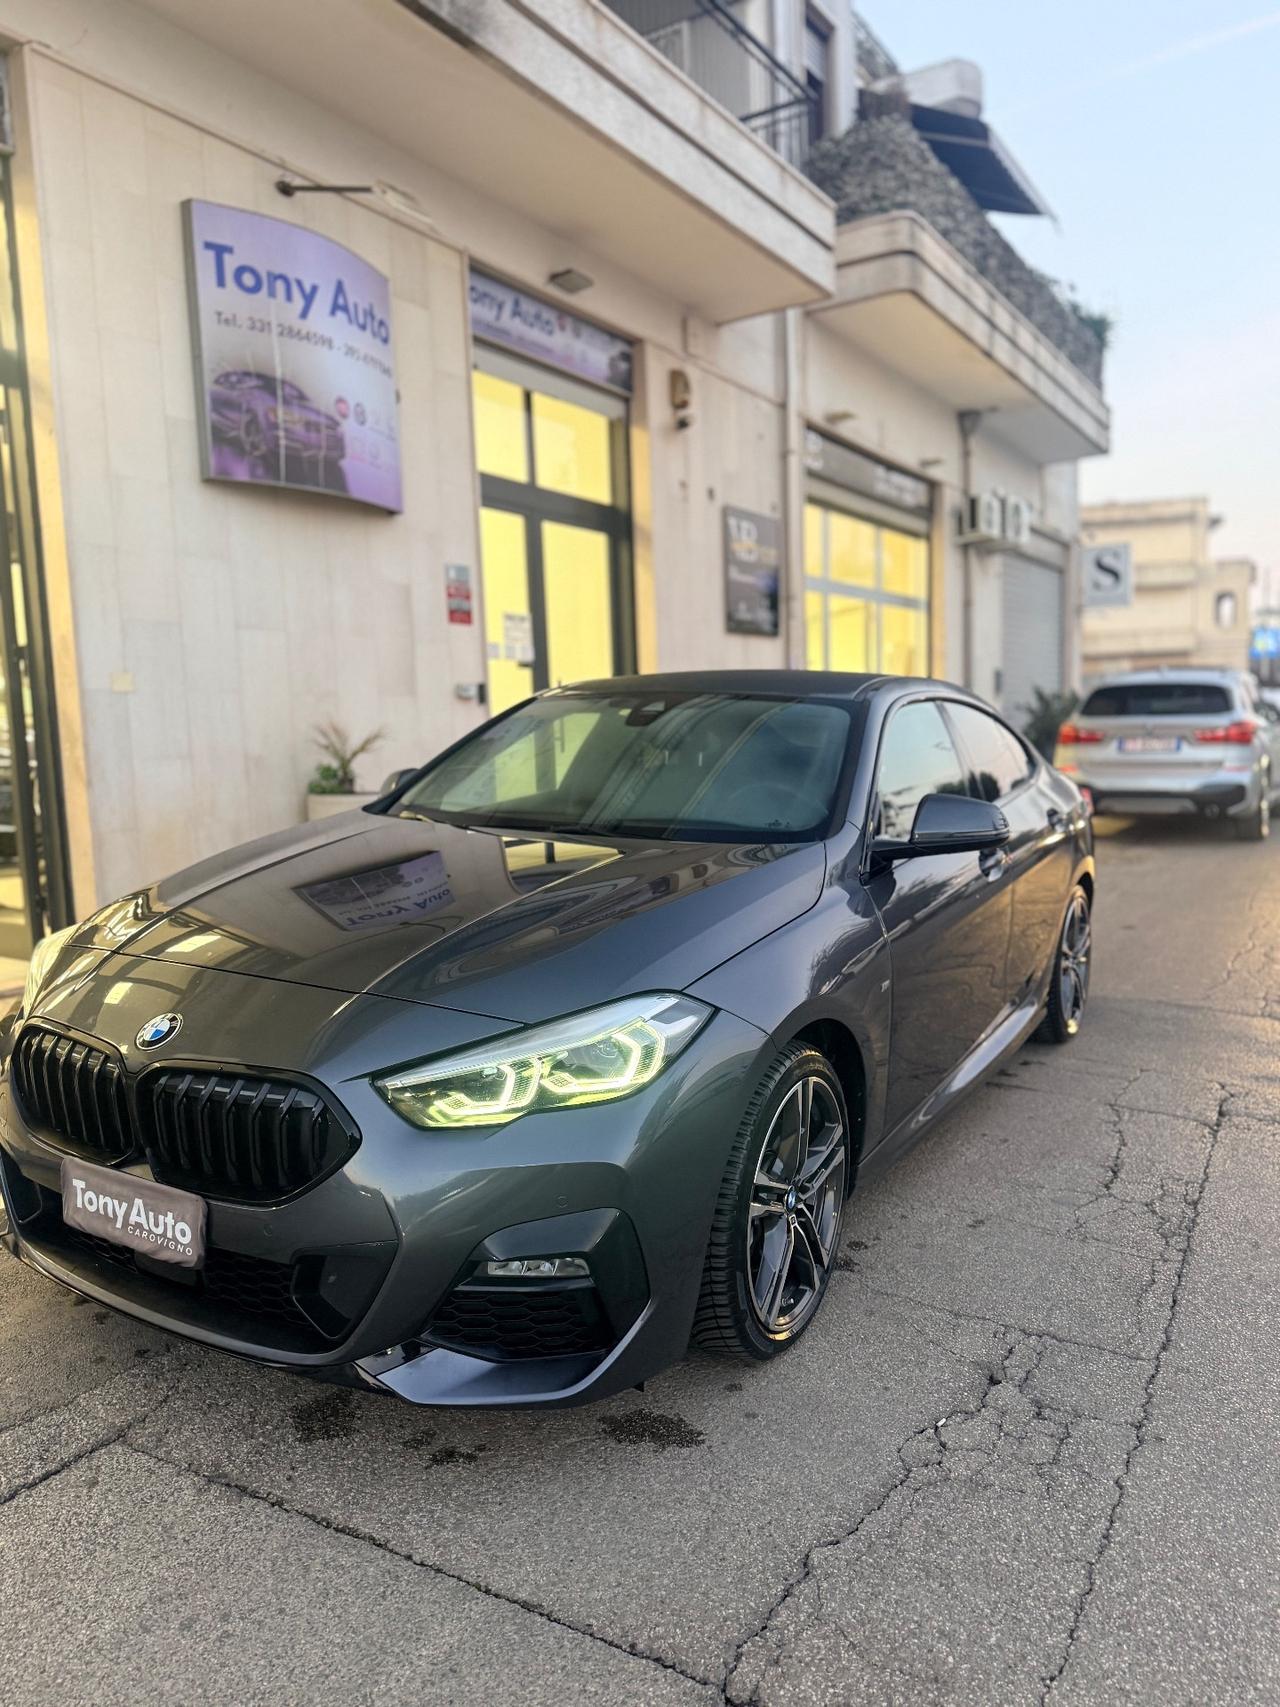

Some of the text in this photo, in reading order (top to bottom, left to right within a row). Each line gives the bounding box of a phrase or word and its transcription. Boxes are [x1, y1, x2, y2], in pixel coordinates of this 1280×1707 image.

[203, 240, 390, 346] Tony Auto
[470, 285, 505, 322] ony
[214, 310, 242, 330] Tel.
[1092, 549, 1121, 593] S
[72, 1178, 192, 1245] Tony Auto
[127, 1225, 193, 1256] CAROVIGNO
